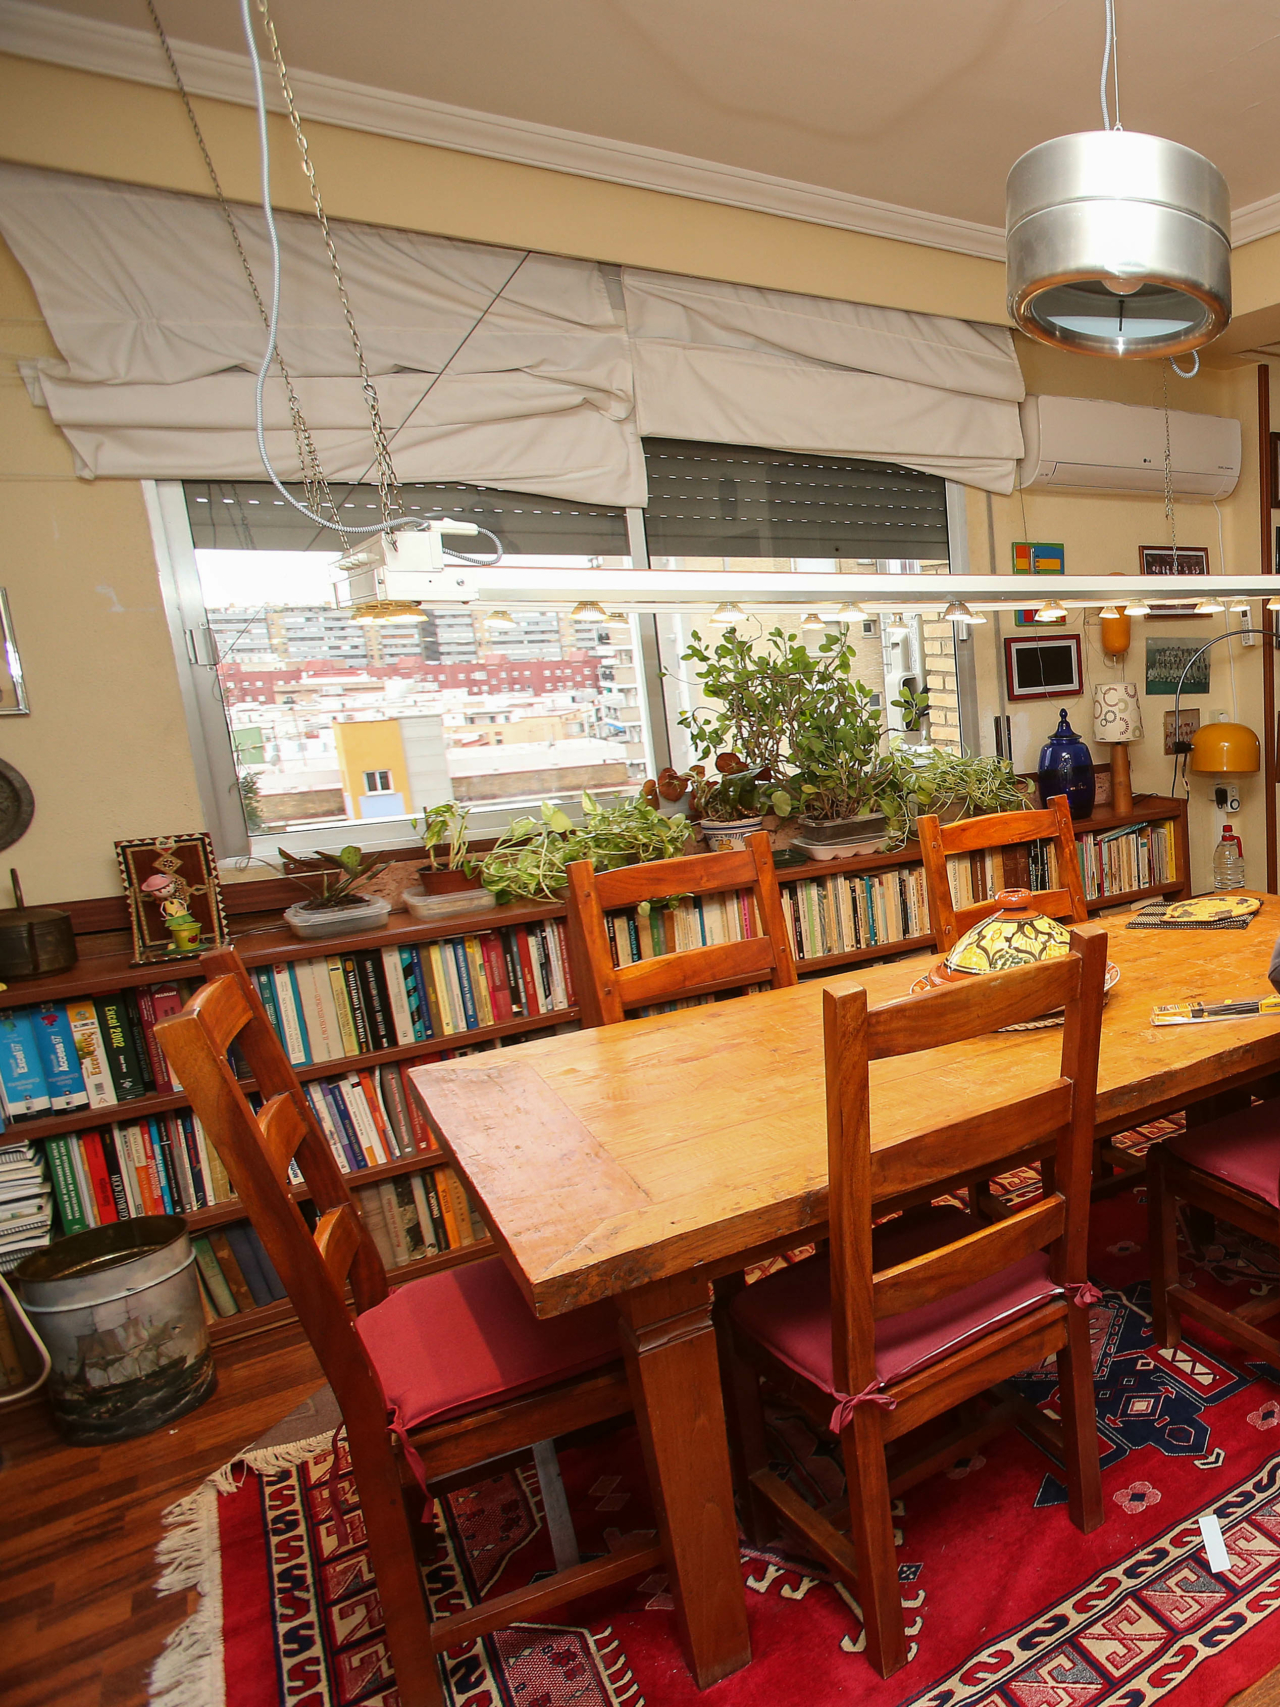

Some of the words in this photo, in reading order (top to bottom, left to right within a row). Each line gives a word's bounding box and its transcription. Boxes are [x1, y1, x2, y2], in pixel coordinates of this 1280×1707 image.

[105, 1005, 117, 1027] Excel
[111, 1027, 125, 1048] 2002
[10, 1042, 22, 1051] 97
[51, 1034, 63, 1043] 97
[16, 1050, 28, 1074] Excel
[56, 1042, 69, 1071] Access
[89, 1053, 102, 1076] Excel
